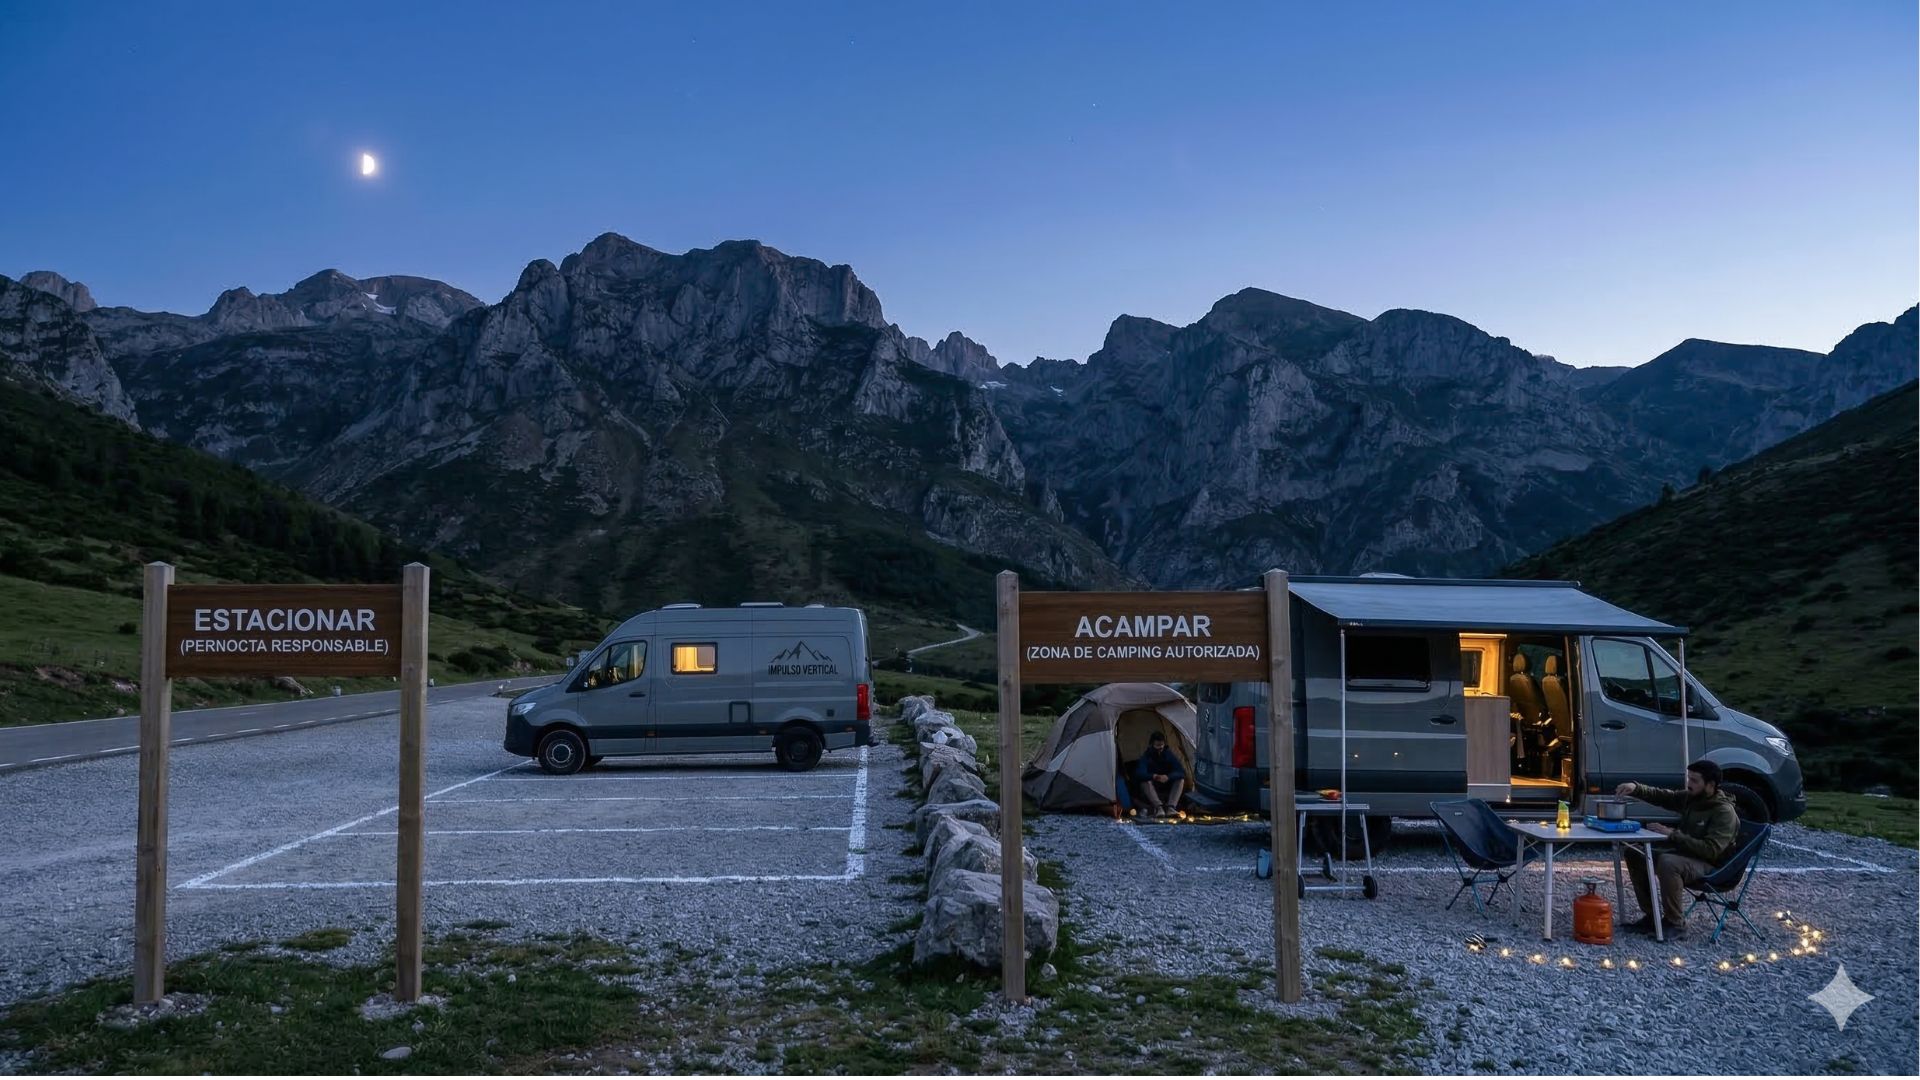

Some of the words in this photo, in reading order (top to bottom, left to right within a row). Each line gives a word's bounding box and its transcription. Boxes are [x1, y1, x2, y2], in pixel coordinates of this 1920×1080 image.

[194, 608, 376, 632] ESTACIONAR
[1074, 615, 1212, 639] ACAMPAR
[180, 639, 267, 656] (PERNOCTA
[271, 639, 389, 656] RESPONSABLE)
[1026, 646, 1071, 662] (ZONA
[1074, 647, 1093, 659] DE
[1096, 646, 1162, 660] CAMPING
[1164, 645, 1260, 662] AUTORIZADA)
[768, 664, 801, 676] IMPULSO
[802, 664, 838, 676] VERTICAL
